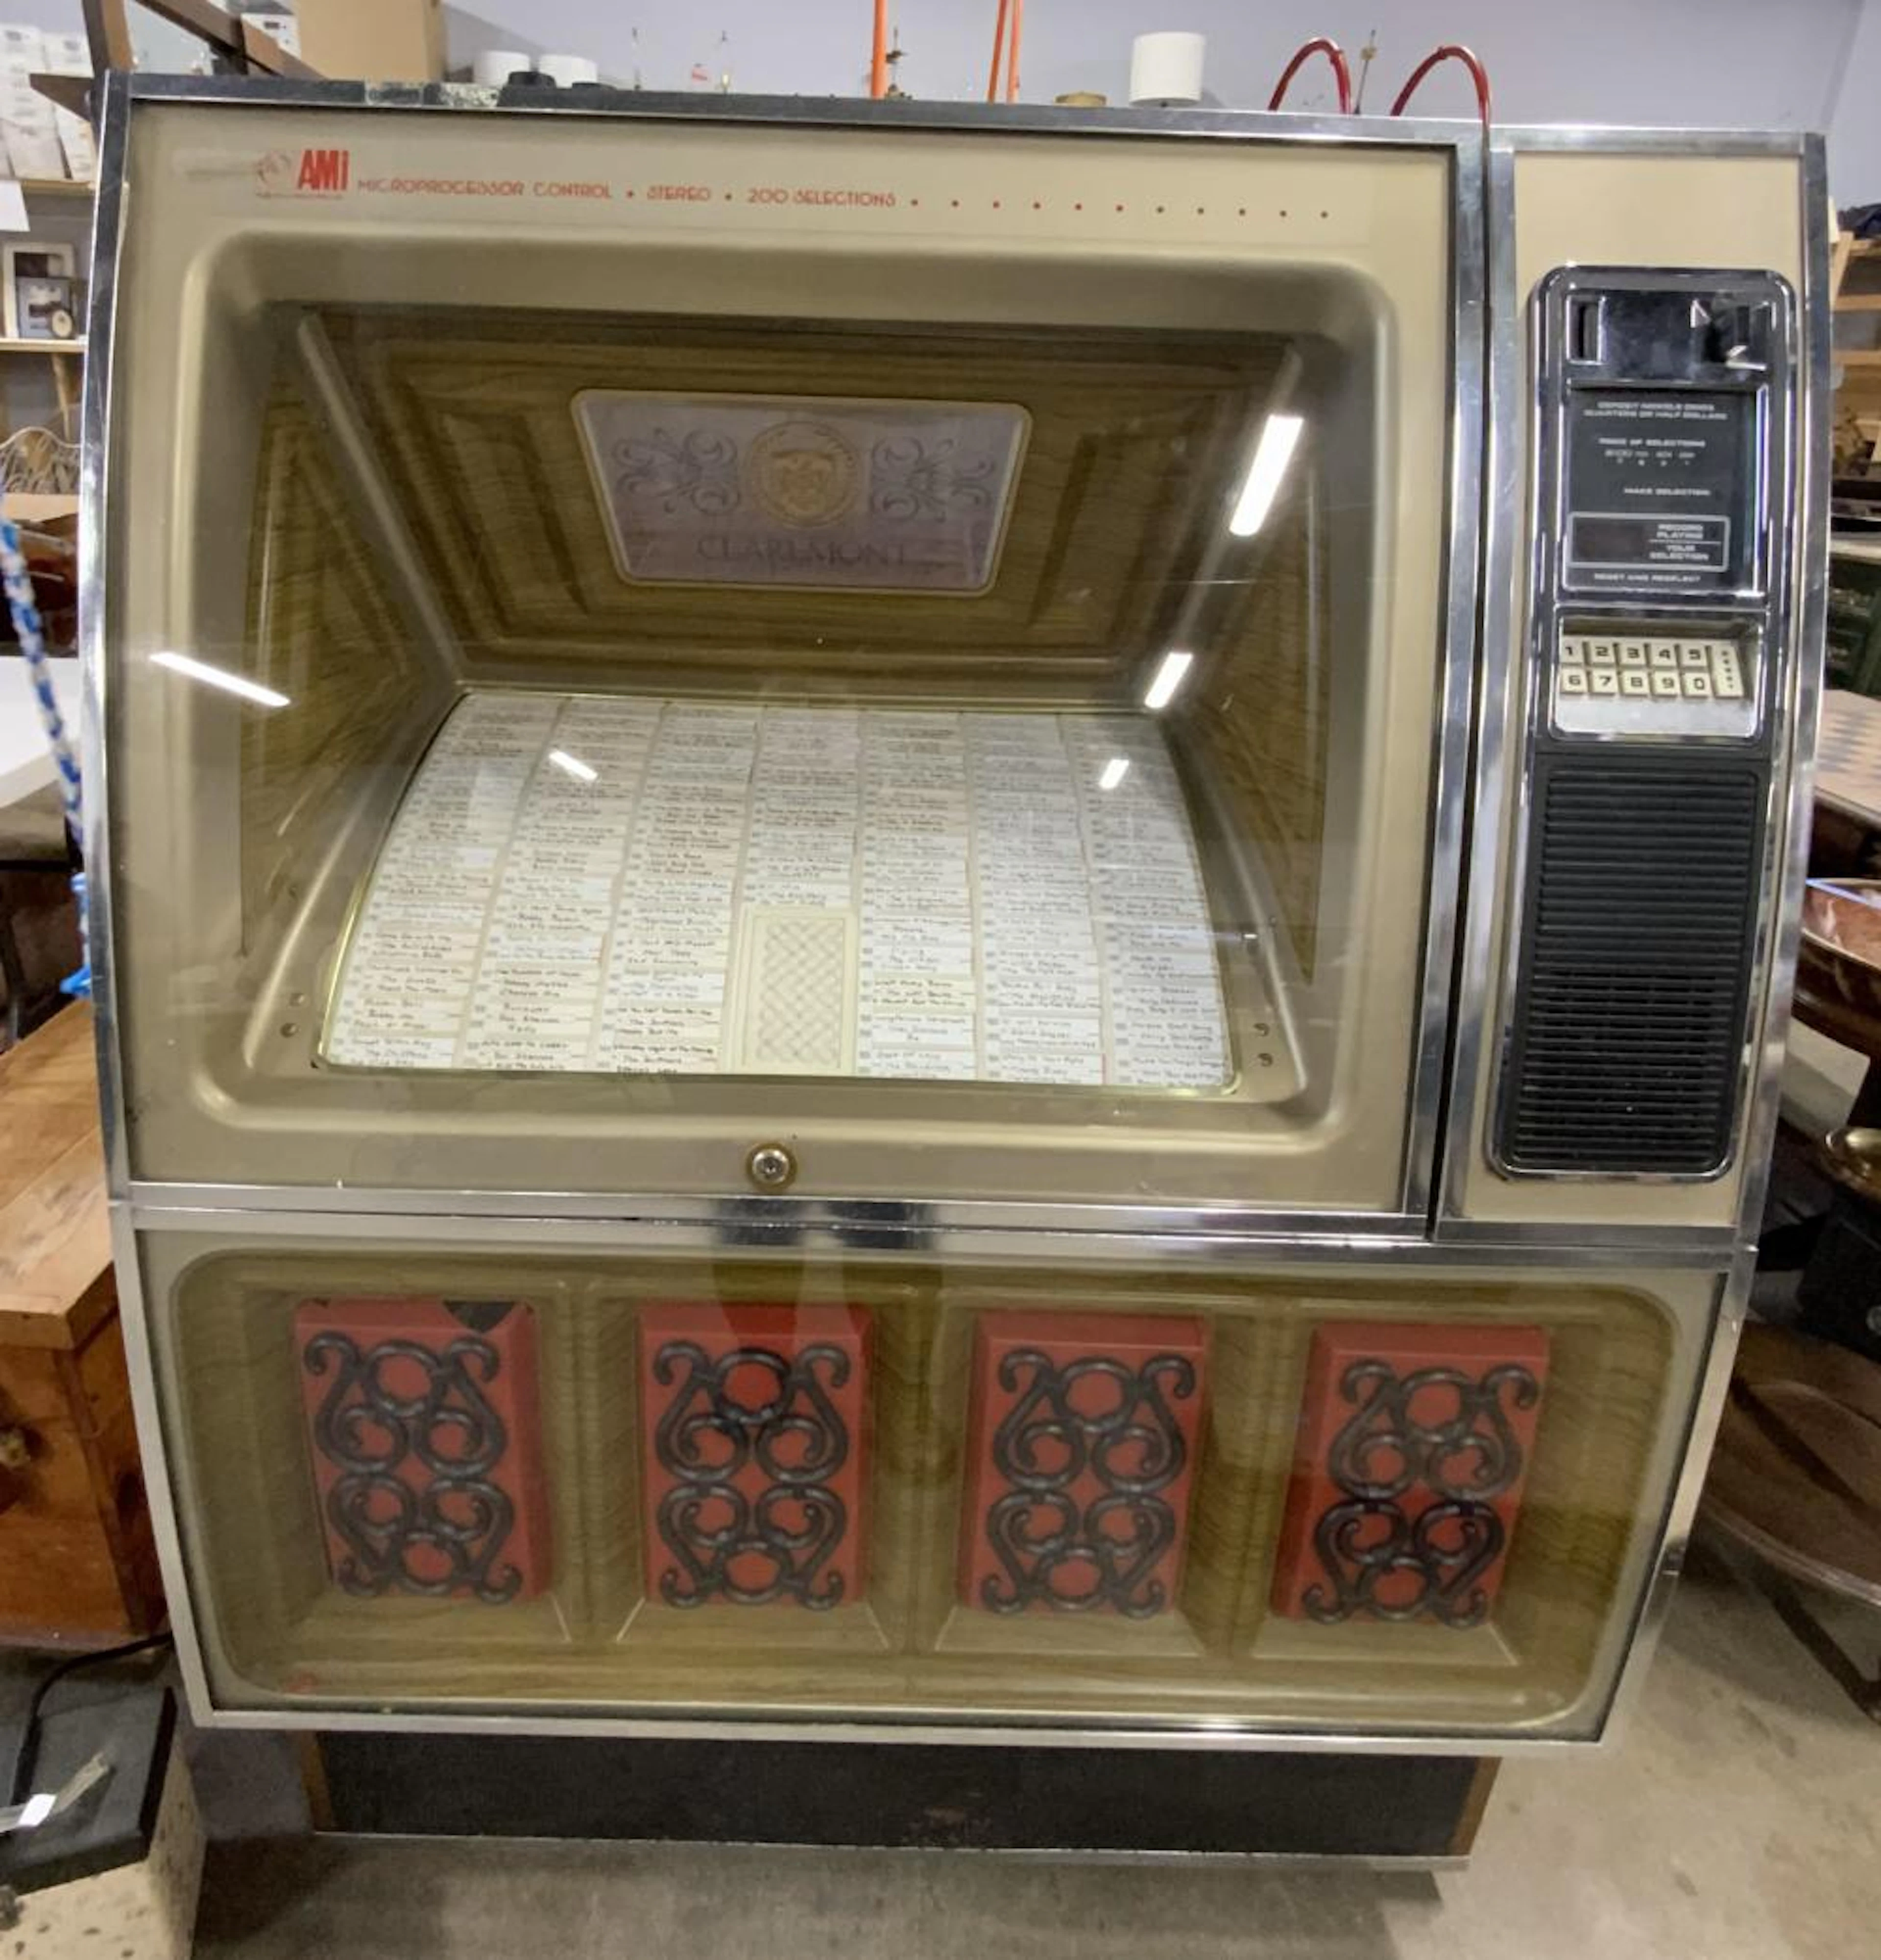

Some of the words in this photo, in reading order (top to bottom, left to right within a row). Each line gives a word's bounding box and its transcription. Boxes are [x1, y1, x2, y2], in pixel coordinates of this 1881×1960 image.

[359, 179, 524, 195] MICROPROCESSOR
[533, 182, 611, 198] CONTROL
[647, 185, 711, 201] STEREO
[748, 188, 788, 203] 200
[794, 189, 895, 206] SELECTIONS
[1565, 646, 1573, 656] 1
[1595, 646, 1610, 657] 2
[1627, 647, 1640, 658] 3
[1659, 648, 1671, 659] 4
[1689, 649, 1701, 660] 5
[1568, 675, 1581, 686] 6
[1599, 676, 1611, 686] 7
[1630, 677, 1643, 687] 8
[1662, 678, 1674, 688] 9
[1694, 678, 1705, 690] 0
